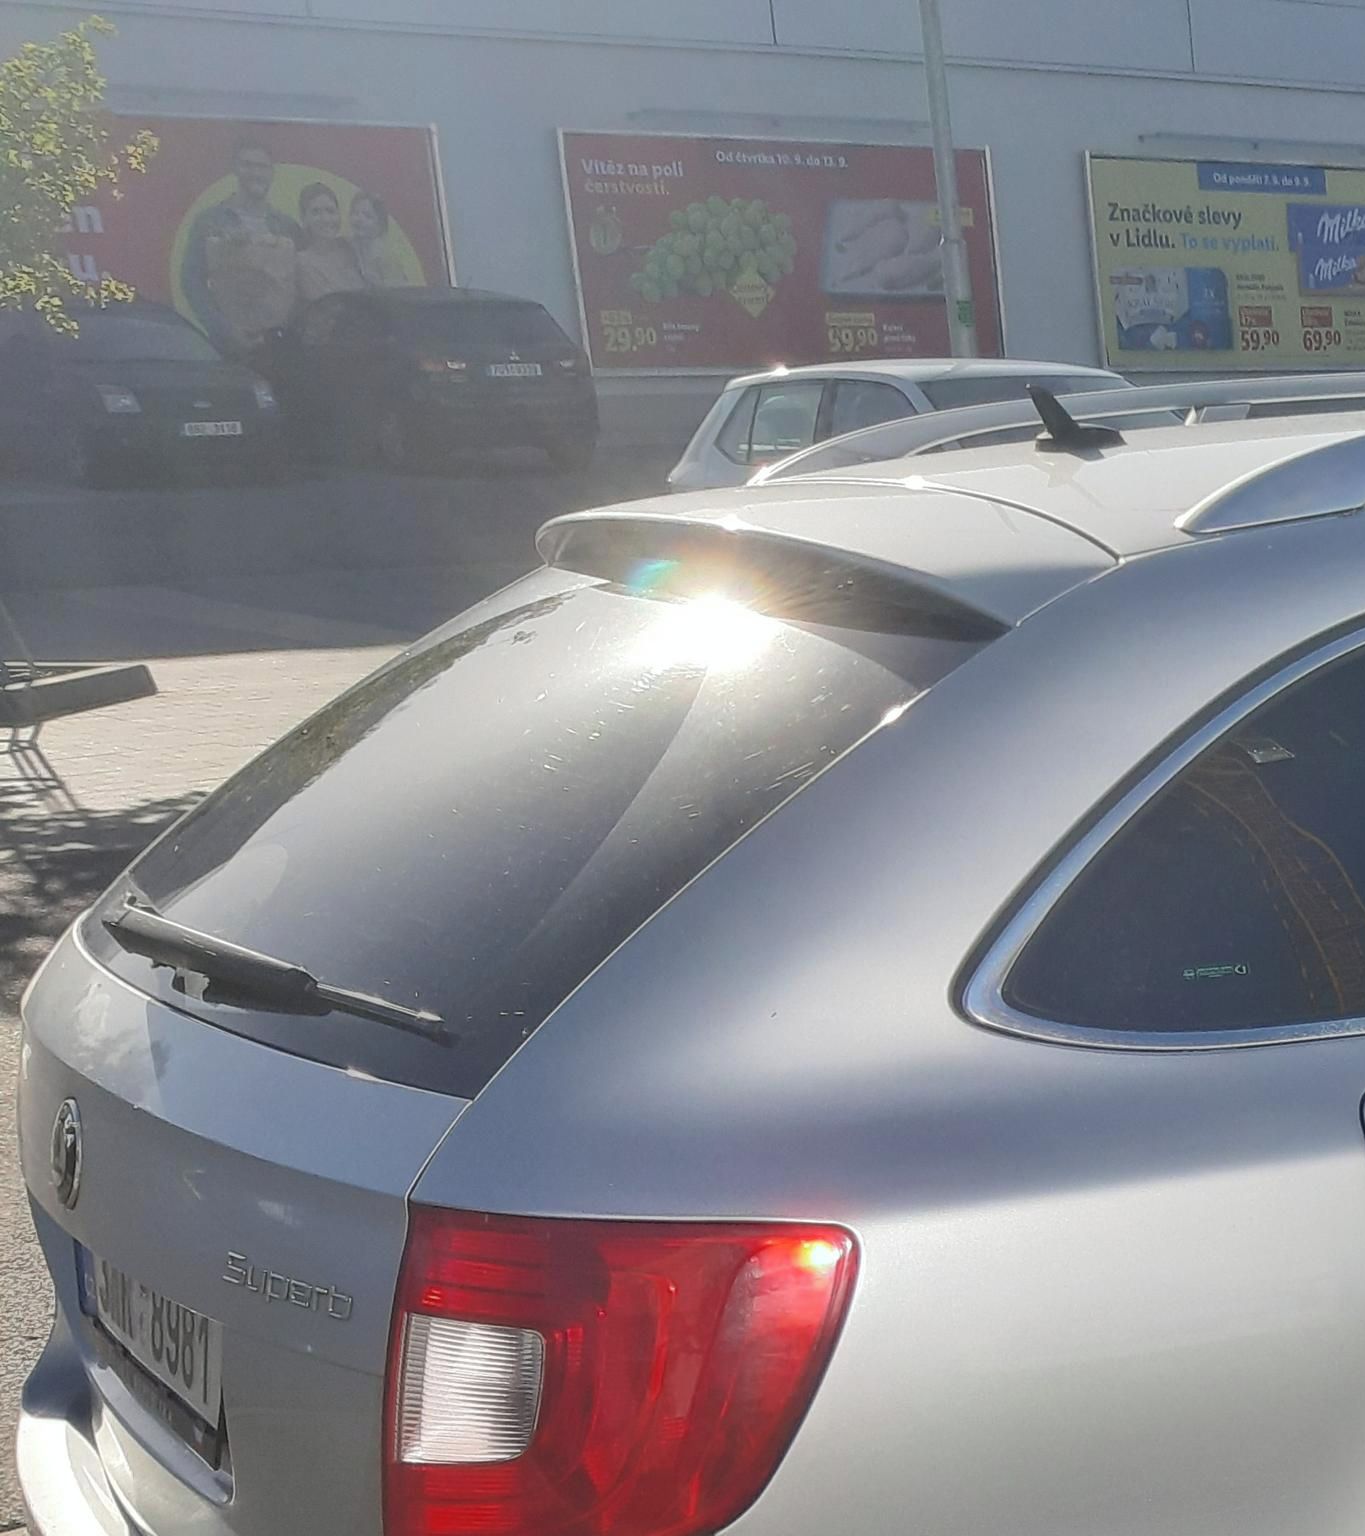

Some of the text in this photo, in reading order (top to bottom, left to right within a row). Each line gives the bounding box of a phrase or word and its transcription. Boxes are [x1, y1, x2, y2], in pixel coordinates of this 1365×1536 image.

[627, 163, 648, 176] na
[1108, 202, 1242, 230] Značkové slevy
[1110, 232, 1120, 247] v
[1126, 228, 1175, 248] Lidlu.
[1183, 232, 1198, 249] To
[1203, 236, 1217, 250] se
[1315, 254, 1357, 281] Milka
[221, 1249, 354, 1321] Superb
